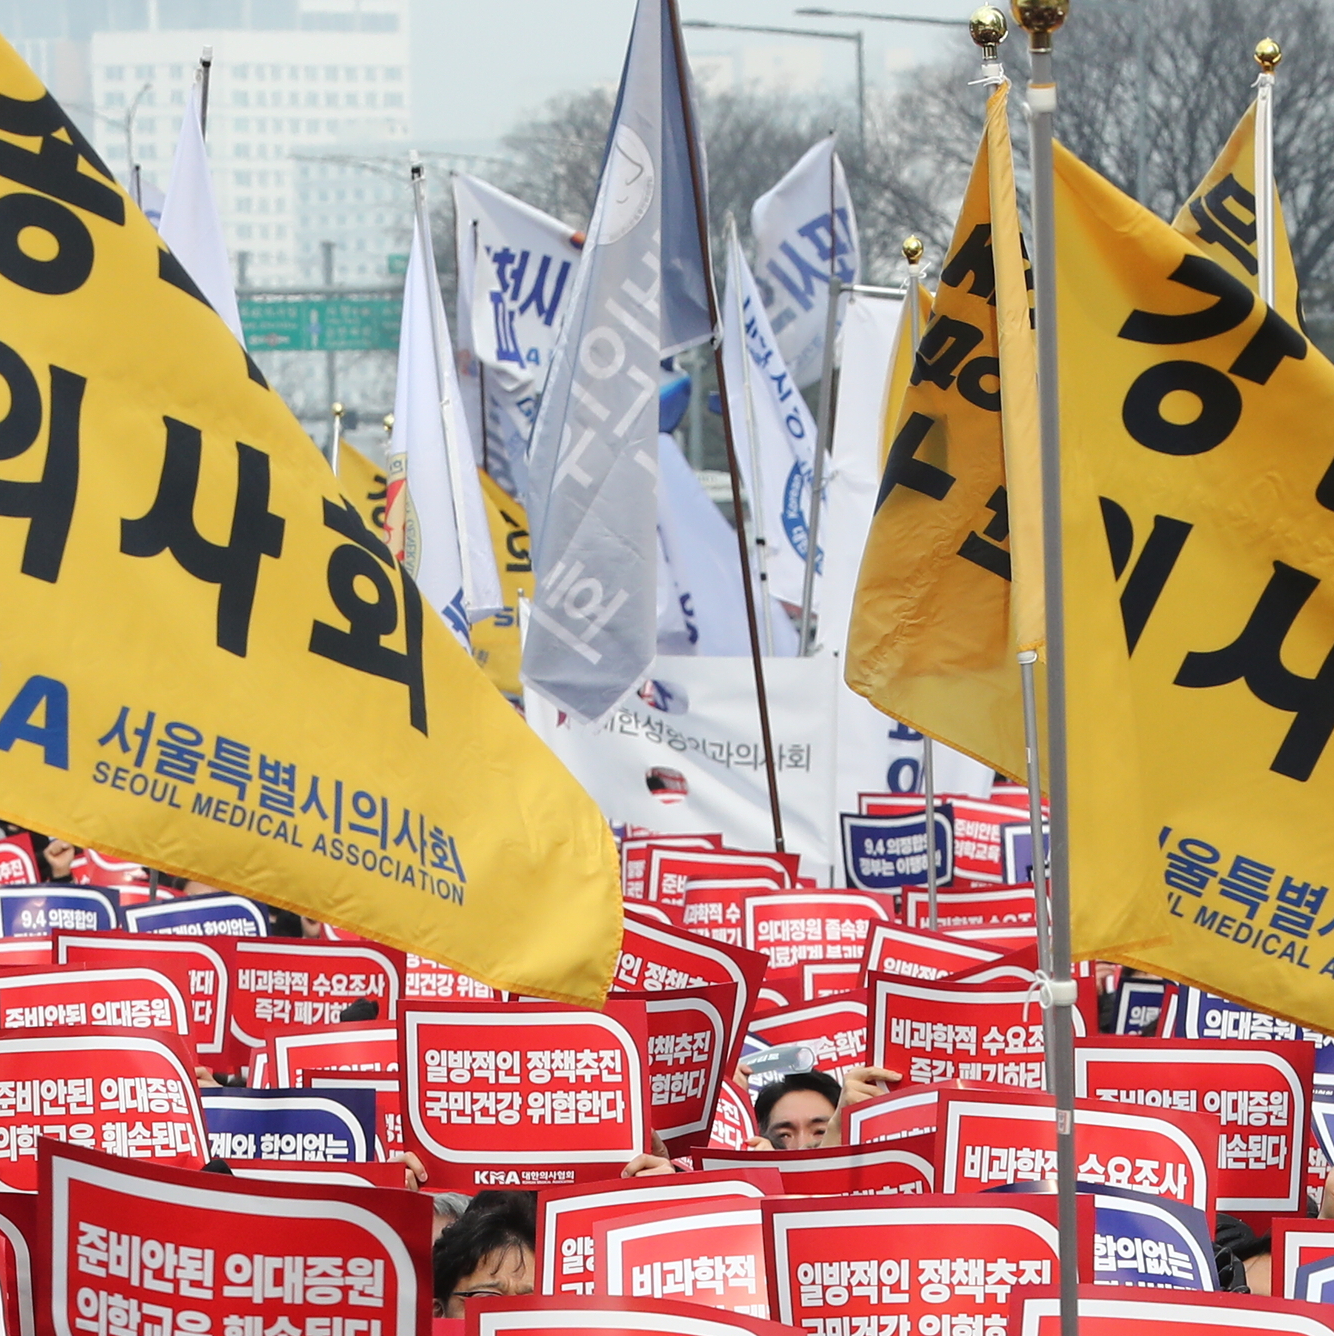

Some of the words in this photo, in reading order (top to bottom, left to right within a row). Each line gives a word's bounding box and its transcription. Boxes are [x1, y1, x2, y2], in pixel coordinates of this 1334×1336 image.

[98, 705, 467, 883] 서울특별시의사회
[92, 761, 182, 810] SEOUL
[192, 795, 304, 848] MEDICAL
[313, 836, 465, 906] ASSOCIATION
[864, 838, 885, 857] 9.4
[21, 909, 46, 929] 9.4
[48, 909, 97, 931] 의정합의
[758, 920, 822, 942] 의대정원
[1193, 907, 1312, 968] MEDICAL
[238, 969, 311, 997] 비과학적
[313, 971, 385, 997] 수요조사
[255, 998, 291, 1024] 즉각
[890, 1018, 976, 1055] 비과학적
[424, 1049, 521, 1084] 일방적인
[526, 1049, 622, 1084] 정책추진
[101, 1077, 188, 1115] 의대증원
[424, 1089, 521, 1125] 국민건강
[526, 1089, 625, 1125] 위협한다
[1203, 1089, 1288, 1126] 의대증원
[474, 1170, 520, 1185] KMA
[522, 1171, 574, 1182] 대한의사협회
[1078, 1152, 1188, 1199] 수요조사
[76, 1222, 215, 1299] 준비안된
[223, 1252, 385, 1309] 의대증원
[632, 1254, 755, 1299] 비과학적
[797, 1259, 910, 1308] 일방적인
